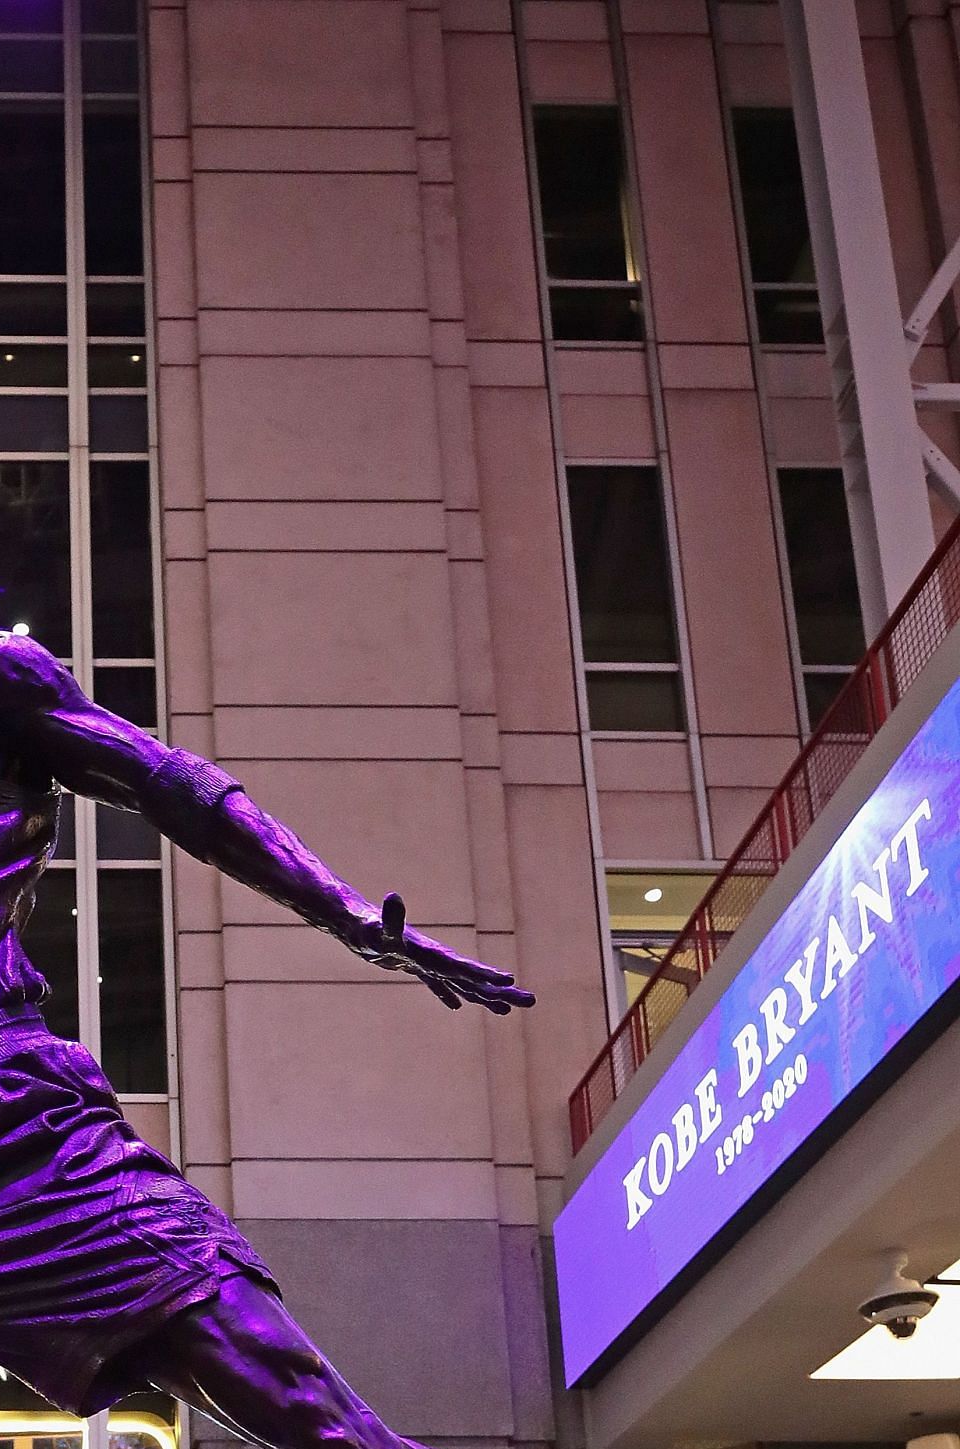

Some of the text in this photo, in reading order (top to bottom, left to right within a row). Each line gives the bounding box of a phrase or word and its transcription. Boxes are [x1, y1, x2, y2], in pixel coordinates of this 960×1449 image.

[622, 797, 934, 1230] KOBE BRYANT
[715, 1053, 809, 1176] 1978-2020
